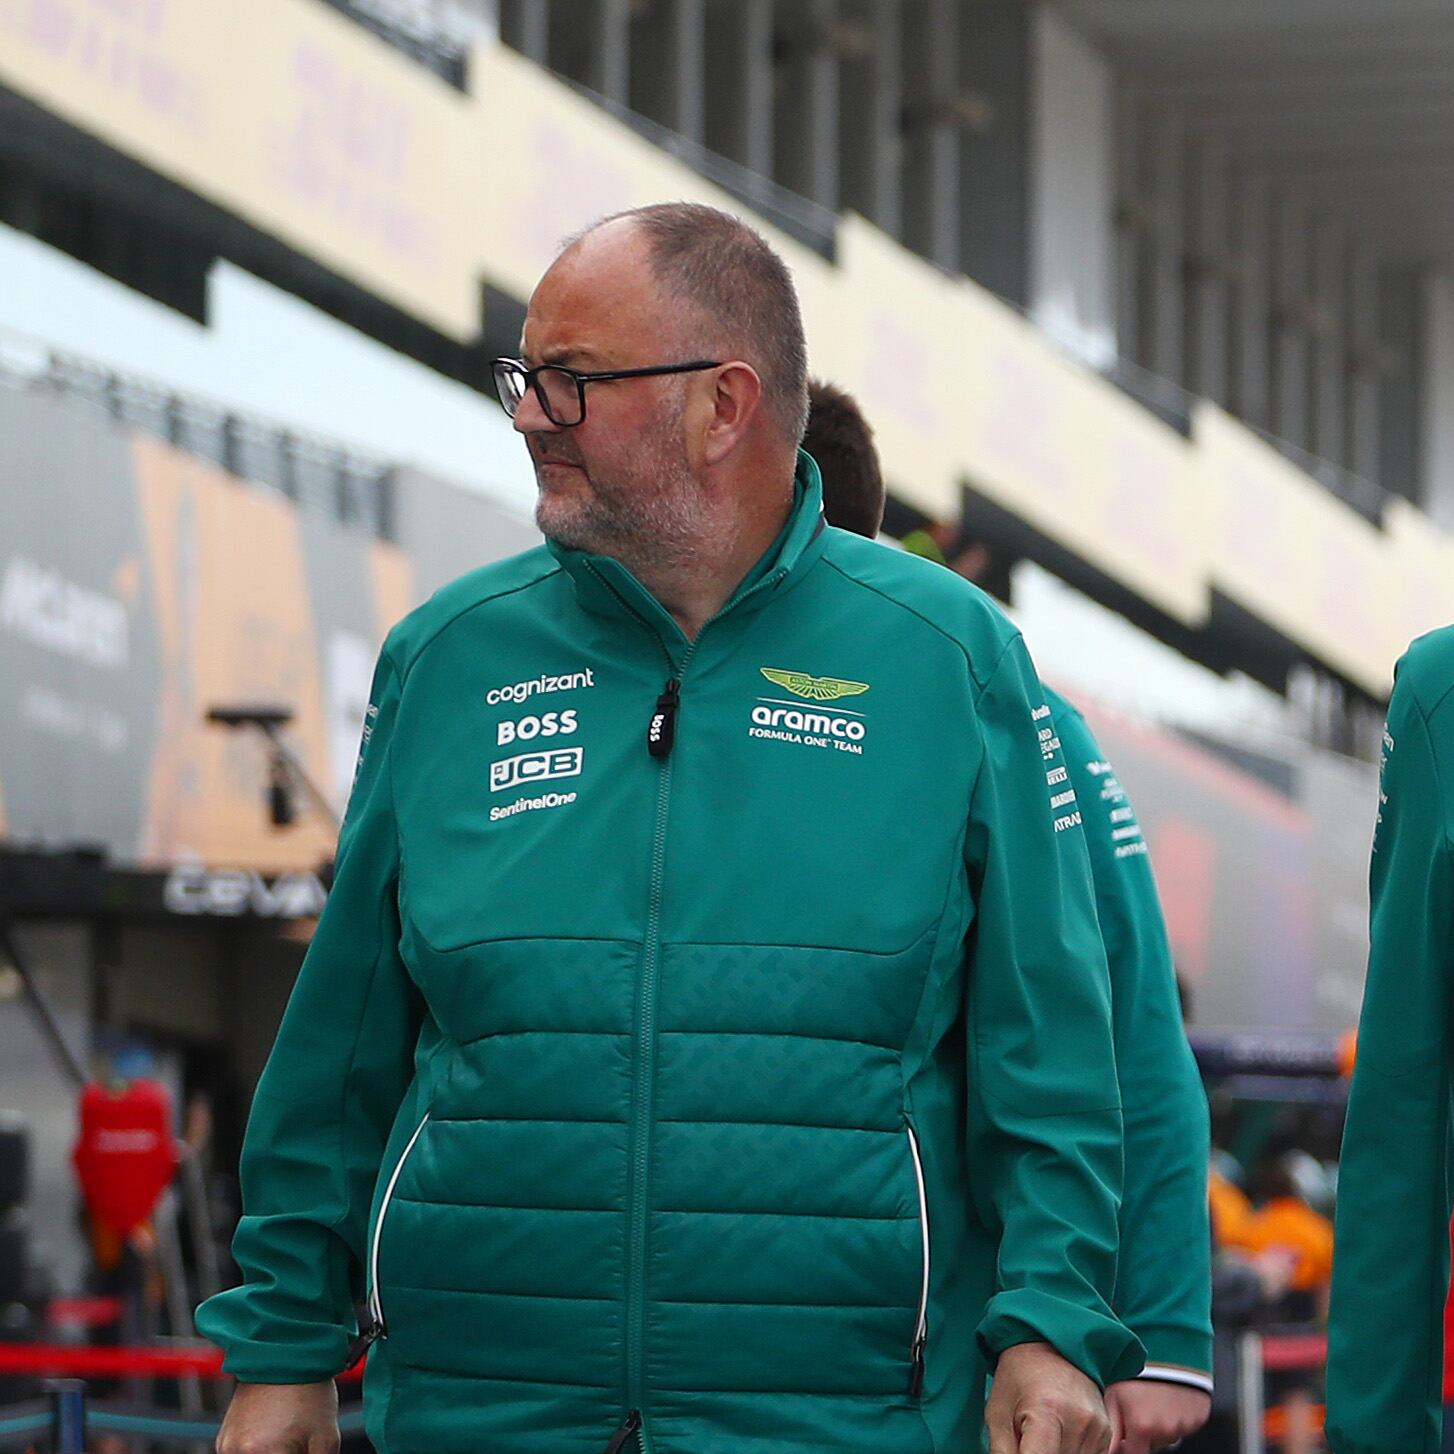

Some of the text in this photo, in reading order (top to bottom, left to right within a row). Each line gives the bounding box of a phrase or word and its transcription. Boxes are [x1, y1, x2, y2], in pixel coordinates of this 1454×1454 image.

[486, 668, 595, 705] cognizant
[497, 709, 579, 745] BOSS
[749, 727, 863, 755] FORMULA ONE TEAM
[752, 706, 866, 741] aramco
[493, 750, 579, 788] JCB
[489, 792, 578, 821] SentinelOne
